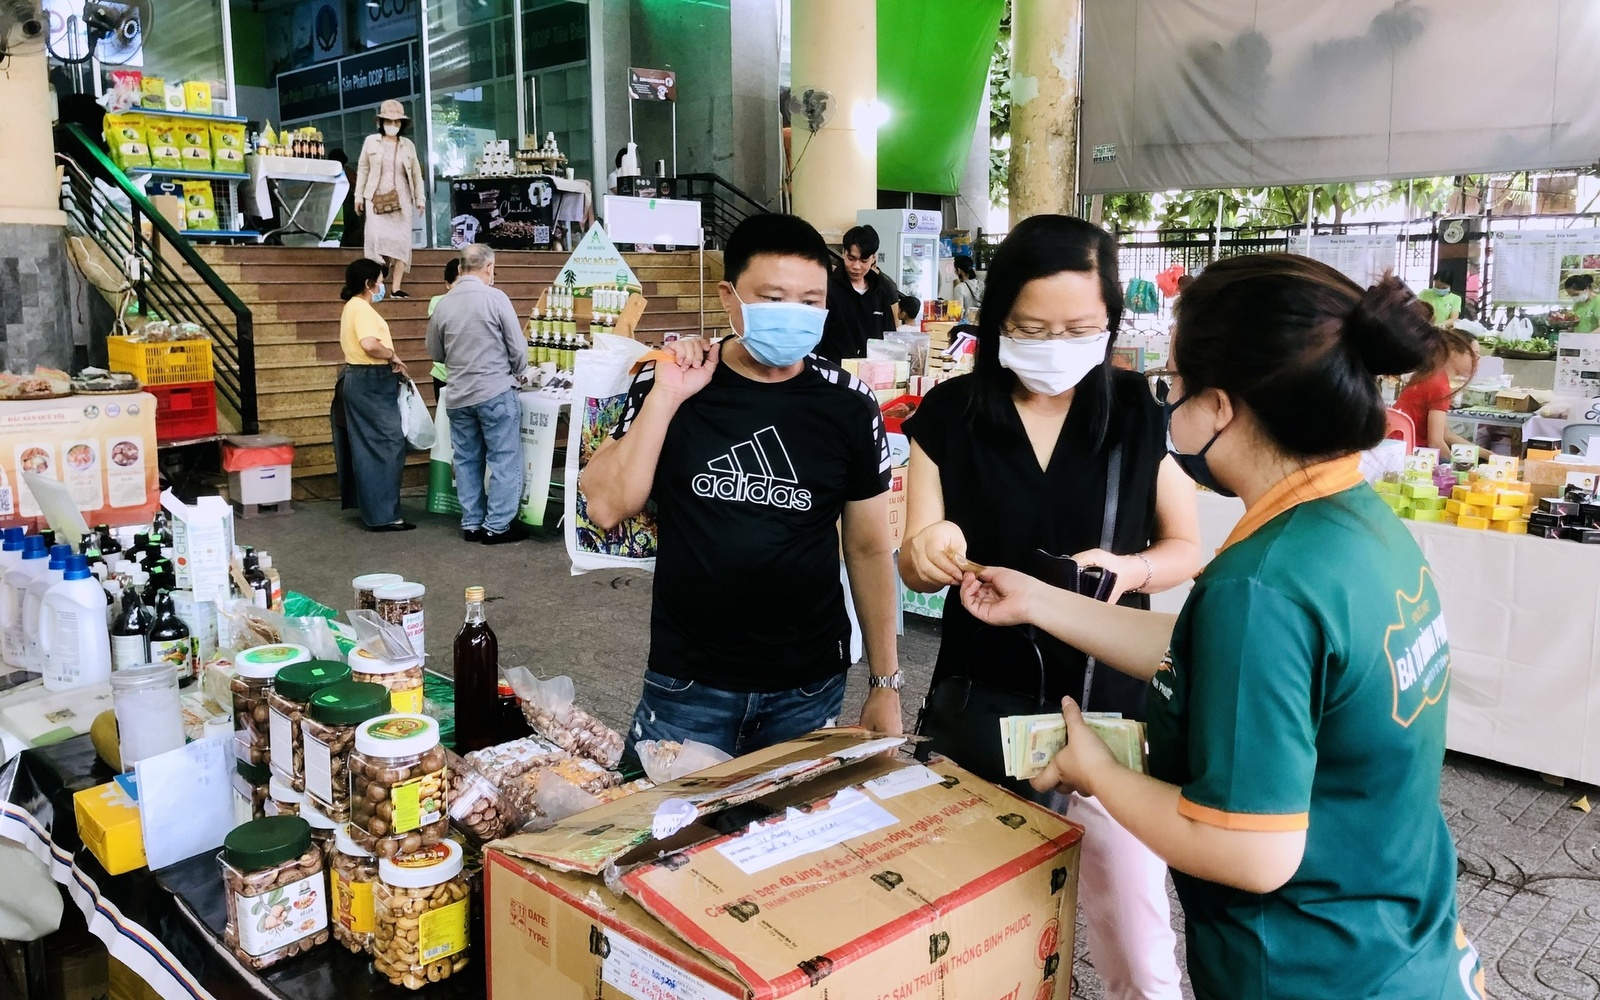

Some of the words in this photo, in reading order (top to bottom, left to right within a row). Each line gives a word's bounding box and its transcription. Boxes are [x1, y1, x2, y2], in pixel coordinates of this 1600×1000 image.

[368, 67, 384, 87] OCOP
[691, 471, 812, 511] adidas
[753, 883, 780, 897] bạn
[779, 875, 797, 887] đã
[795, 868, 822, 881] ủng
[909, 812, 944, 833] nghiệp
[940, 804, 963, 818] Việt
[761, 895, 789, 911] THANK
[787, 888, 805, 899] YOU
[527, 908, 549, 928] DATE:
[527, 928, 549, 949] TYPE:
